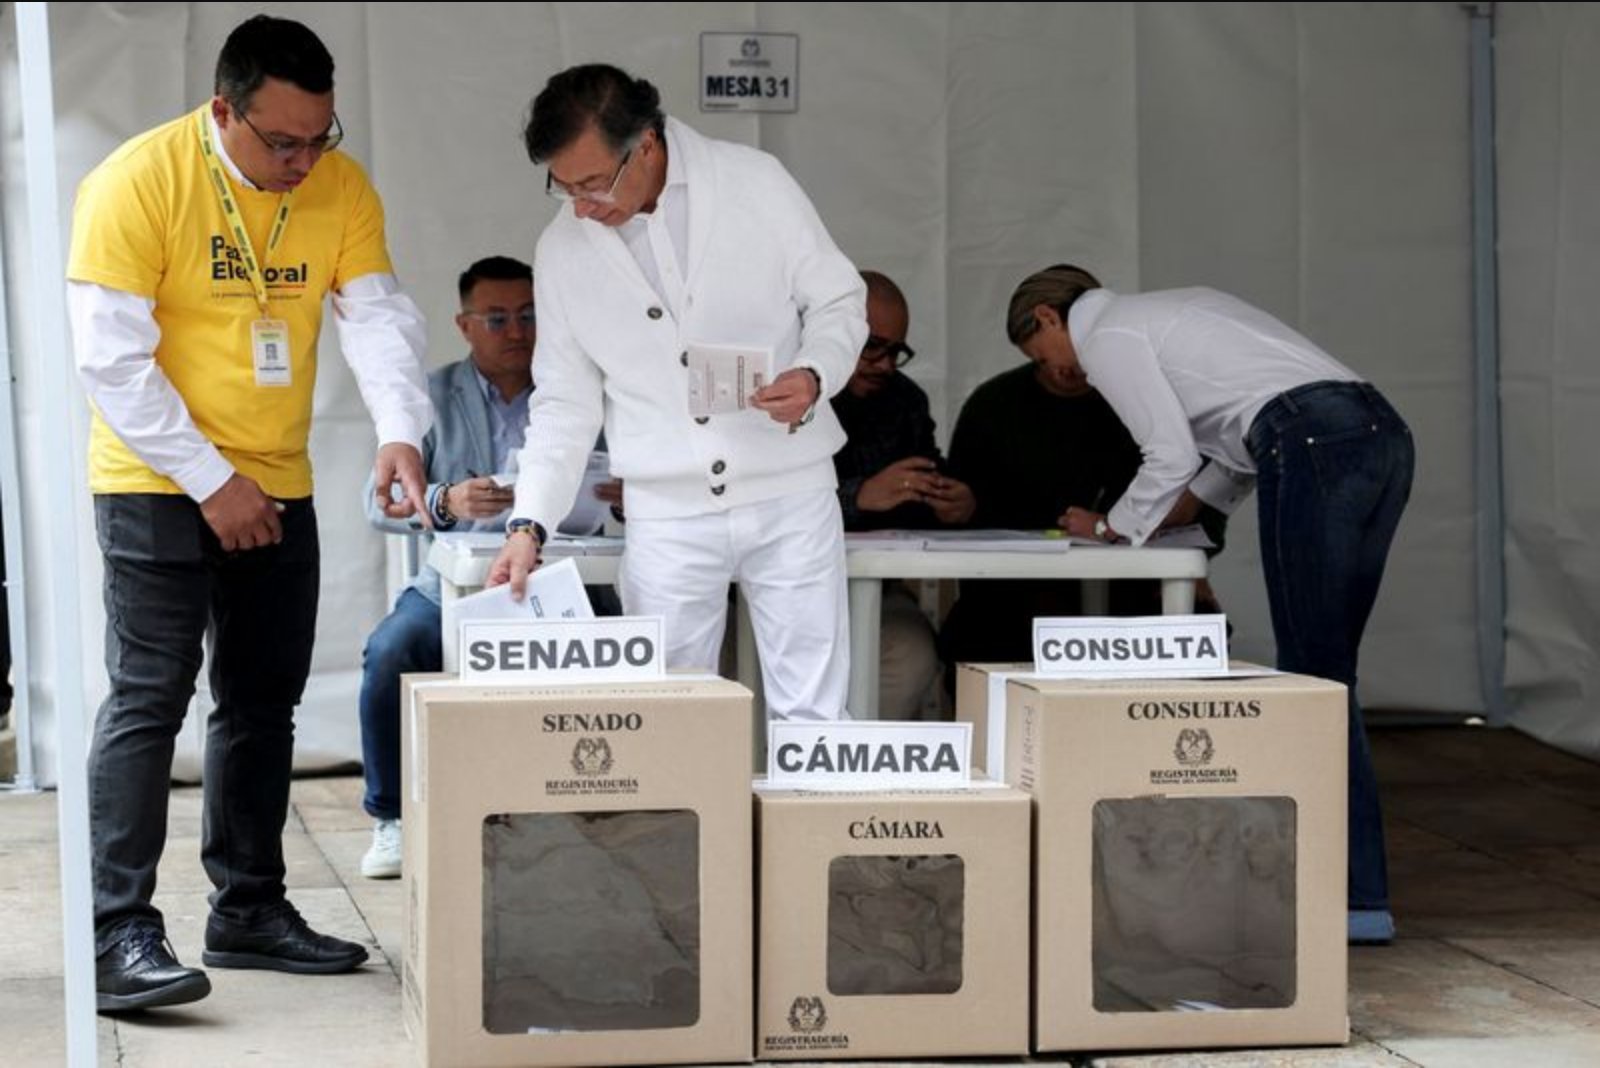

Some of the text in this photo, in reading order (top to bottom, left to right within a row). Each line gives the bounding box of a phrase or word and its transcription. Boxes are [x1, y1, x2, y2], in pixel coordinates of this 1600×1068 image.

[706, 75, 789, 98] MESA 31
[468, 636, 655, 671] SENADO
[1041, 636, 1218, 662] CONSULTA
[542, 712, 643, 732] SENADO
[1127, 700, 1262, 720] CONSULTAS
[777, 735, 960, 773] CÁMARA
[848, 816, 944, 840] CÁMARA
